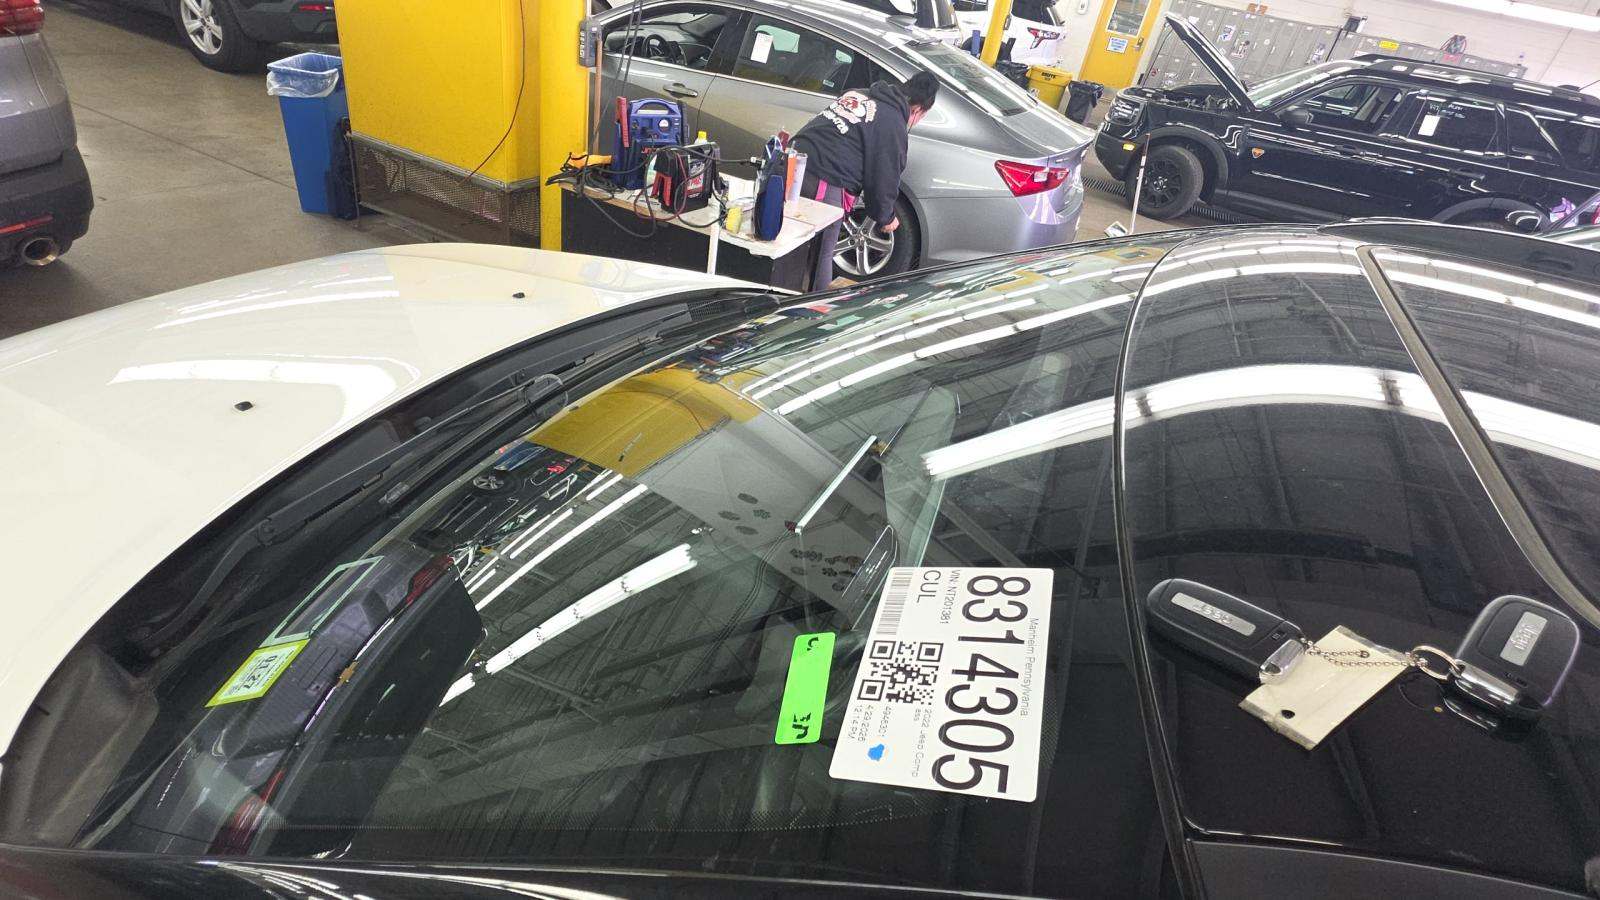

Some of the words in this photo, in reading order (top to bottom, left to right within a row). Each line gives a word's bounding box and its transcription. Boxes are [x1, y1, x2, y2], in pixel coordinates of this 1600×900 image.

[916, 569, 941, 603] CUL
[940, 586, 957, 624] NT201381
[1026, 617, 1039, 654] Manheim
[931, 575, 1032, 794] 8314305
[1020, 656, 1036, 716] Pennsylvania
[921, 708, 932, 728] 2022
[917, 730, 927, 750] Jeep
[911, 752, 924, 778] Comp
